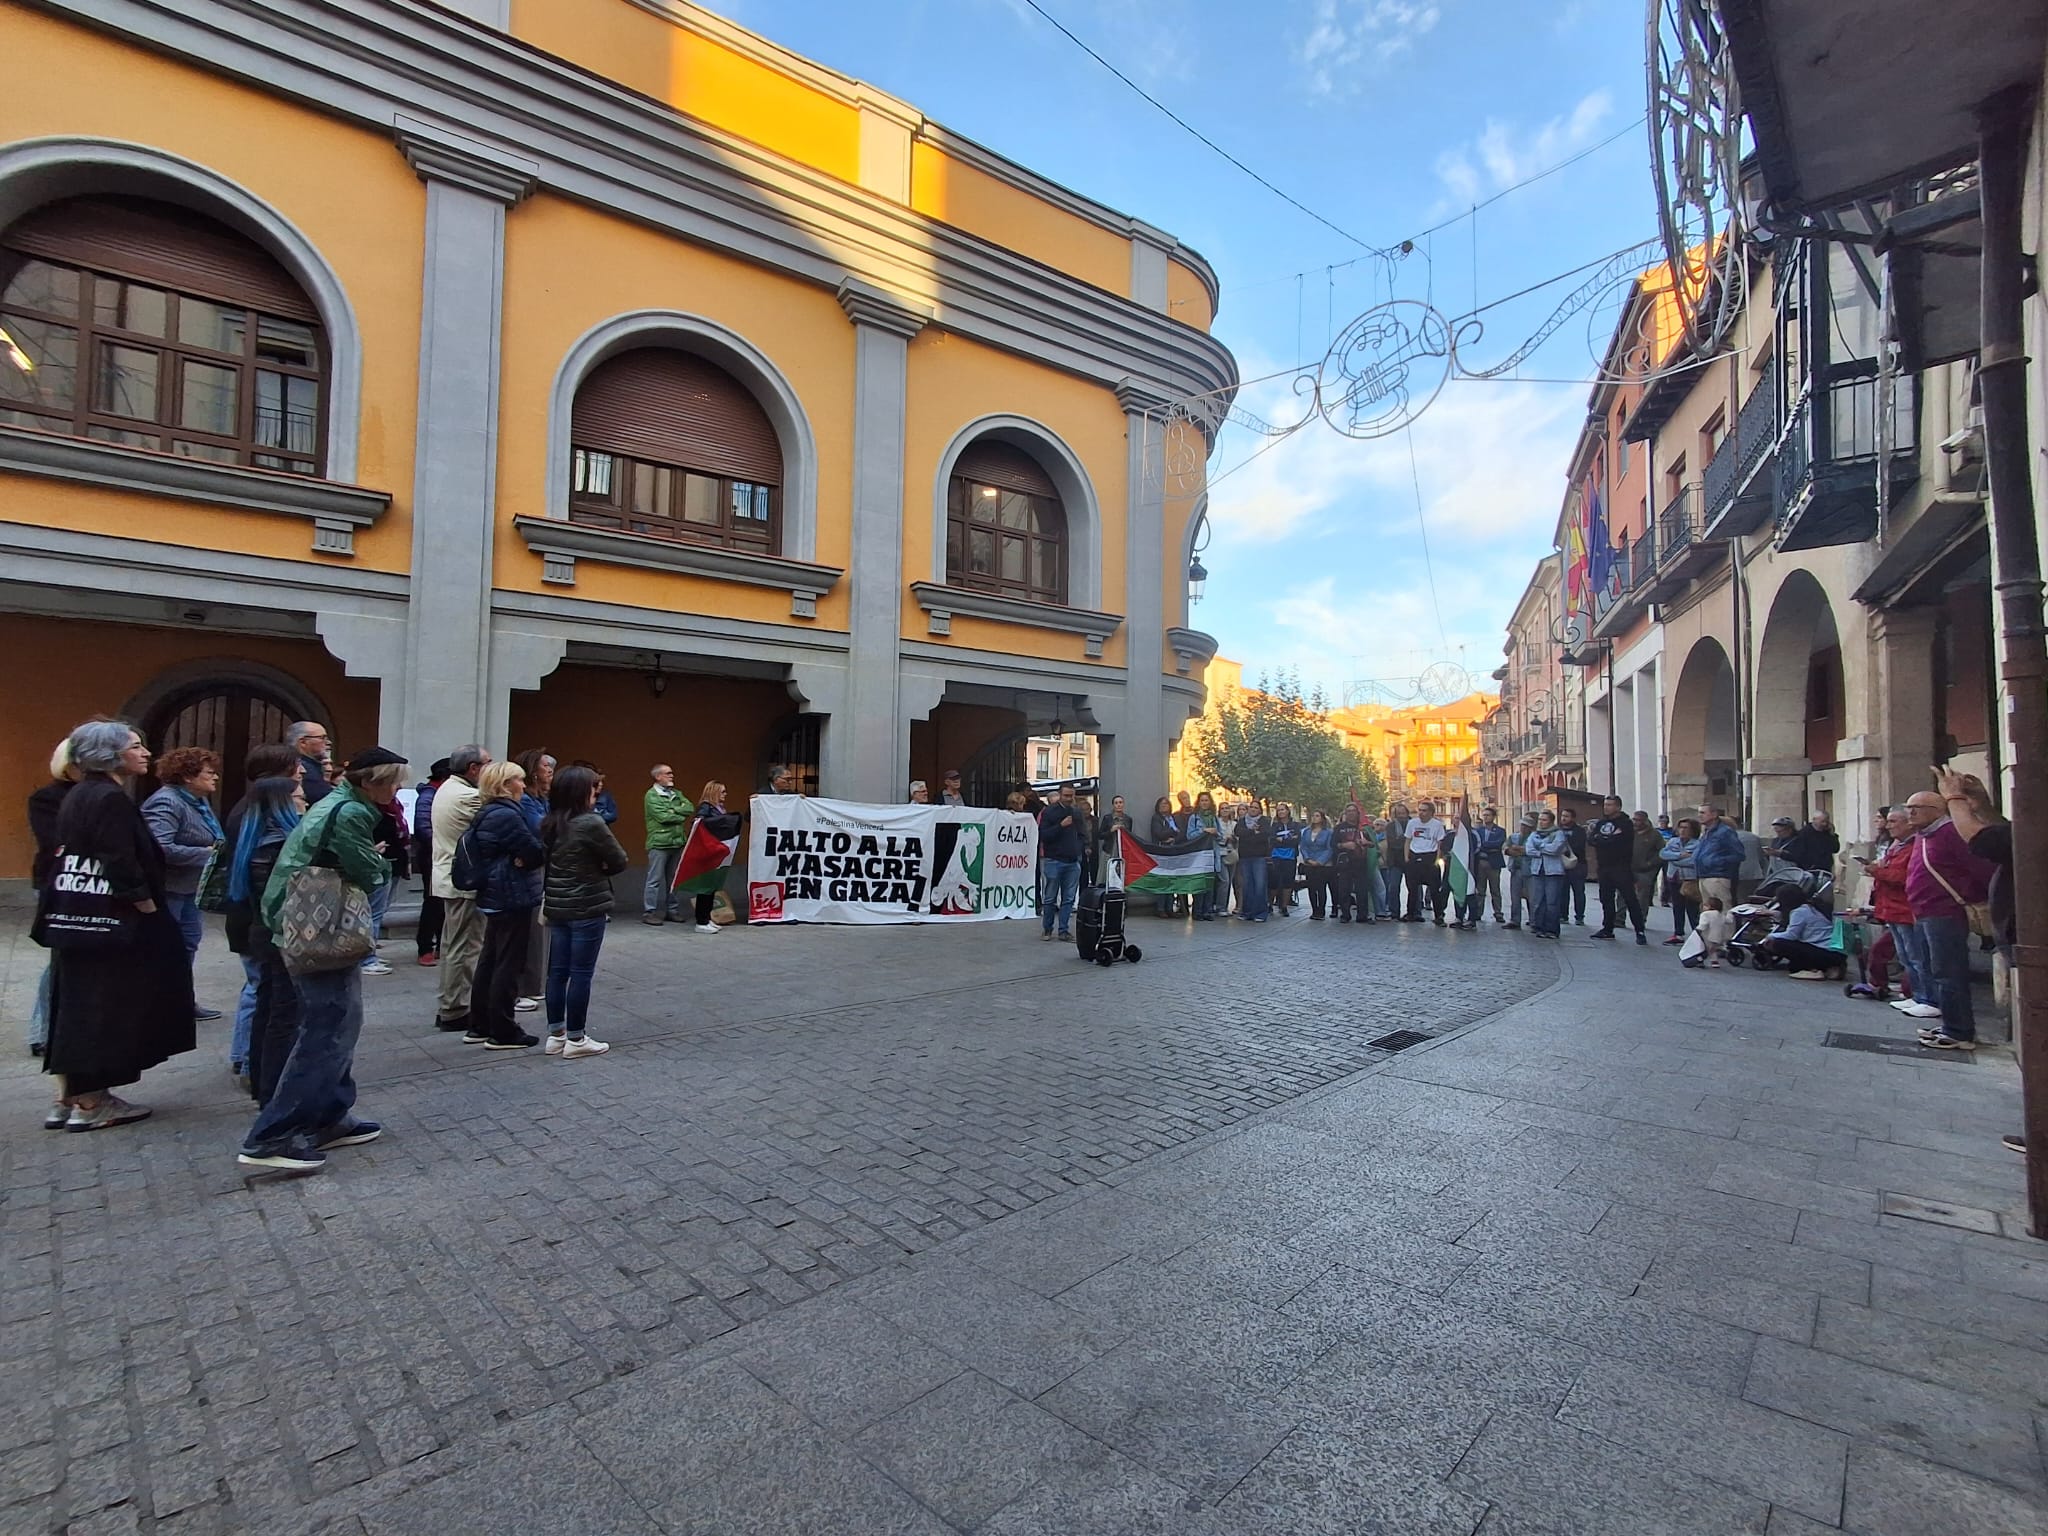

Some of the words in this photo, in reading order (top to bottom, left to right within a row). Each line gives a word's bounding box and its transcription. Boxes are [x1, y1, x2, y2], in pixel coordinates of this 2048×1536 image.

[765, 827, 851, 857] ¡ALTO
[856, 835, 880, 856] A
[886, 836, 923, 858] LA
[997, 825, 1028, 844] GAZA
[64, 854, 104, 876] PLAN
[776, 853, 921, 880] MASACRE
[995, 854, 1029, 869] SOMOS
[784, 877, 823, 900] EN
[829, 875, 927, 912] GAZA!
[982, 884, 1035, 910] TODOS
